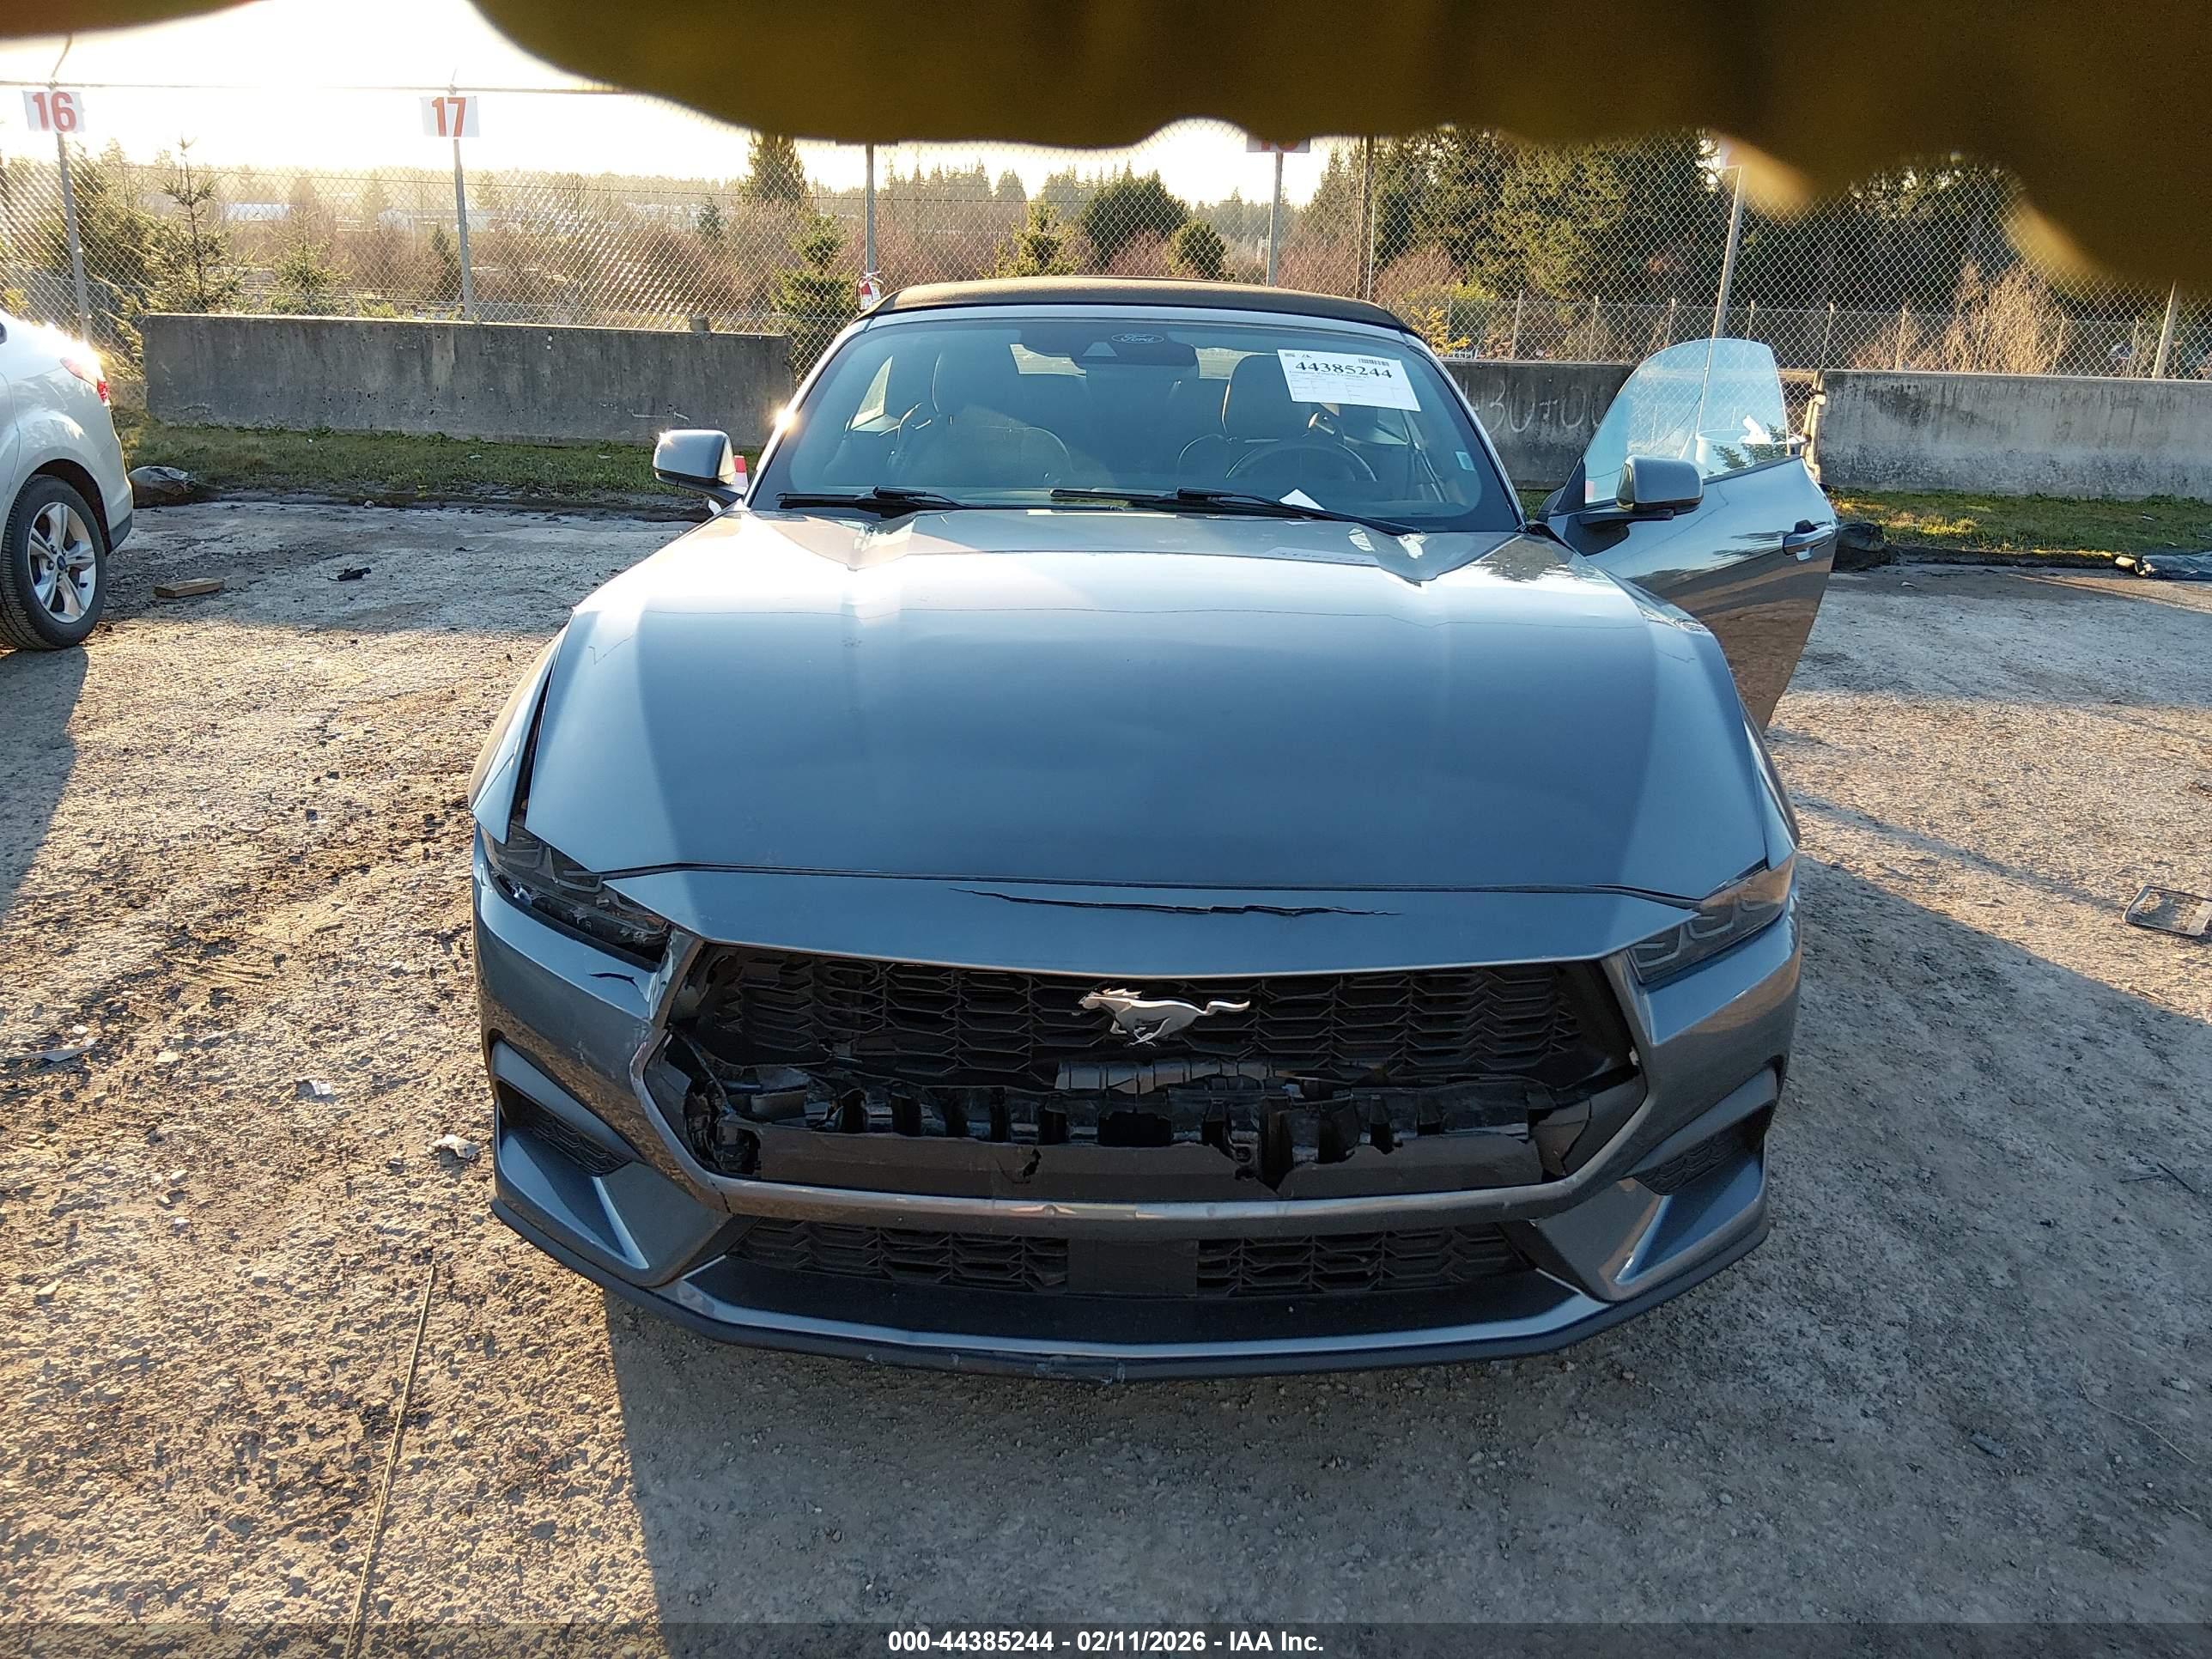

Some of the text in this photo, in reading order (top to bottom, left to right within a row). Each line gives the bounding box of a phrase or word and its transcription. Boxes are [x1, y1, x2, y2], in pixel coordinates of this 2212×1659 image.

[33, 91, 76, 131] 16
[432, 96, 466, 137] 17
[1120, 334, 1156, 343] Ford
[1295, 362, 1393, 379] 44385244
